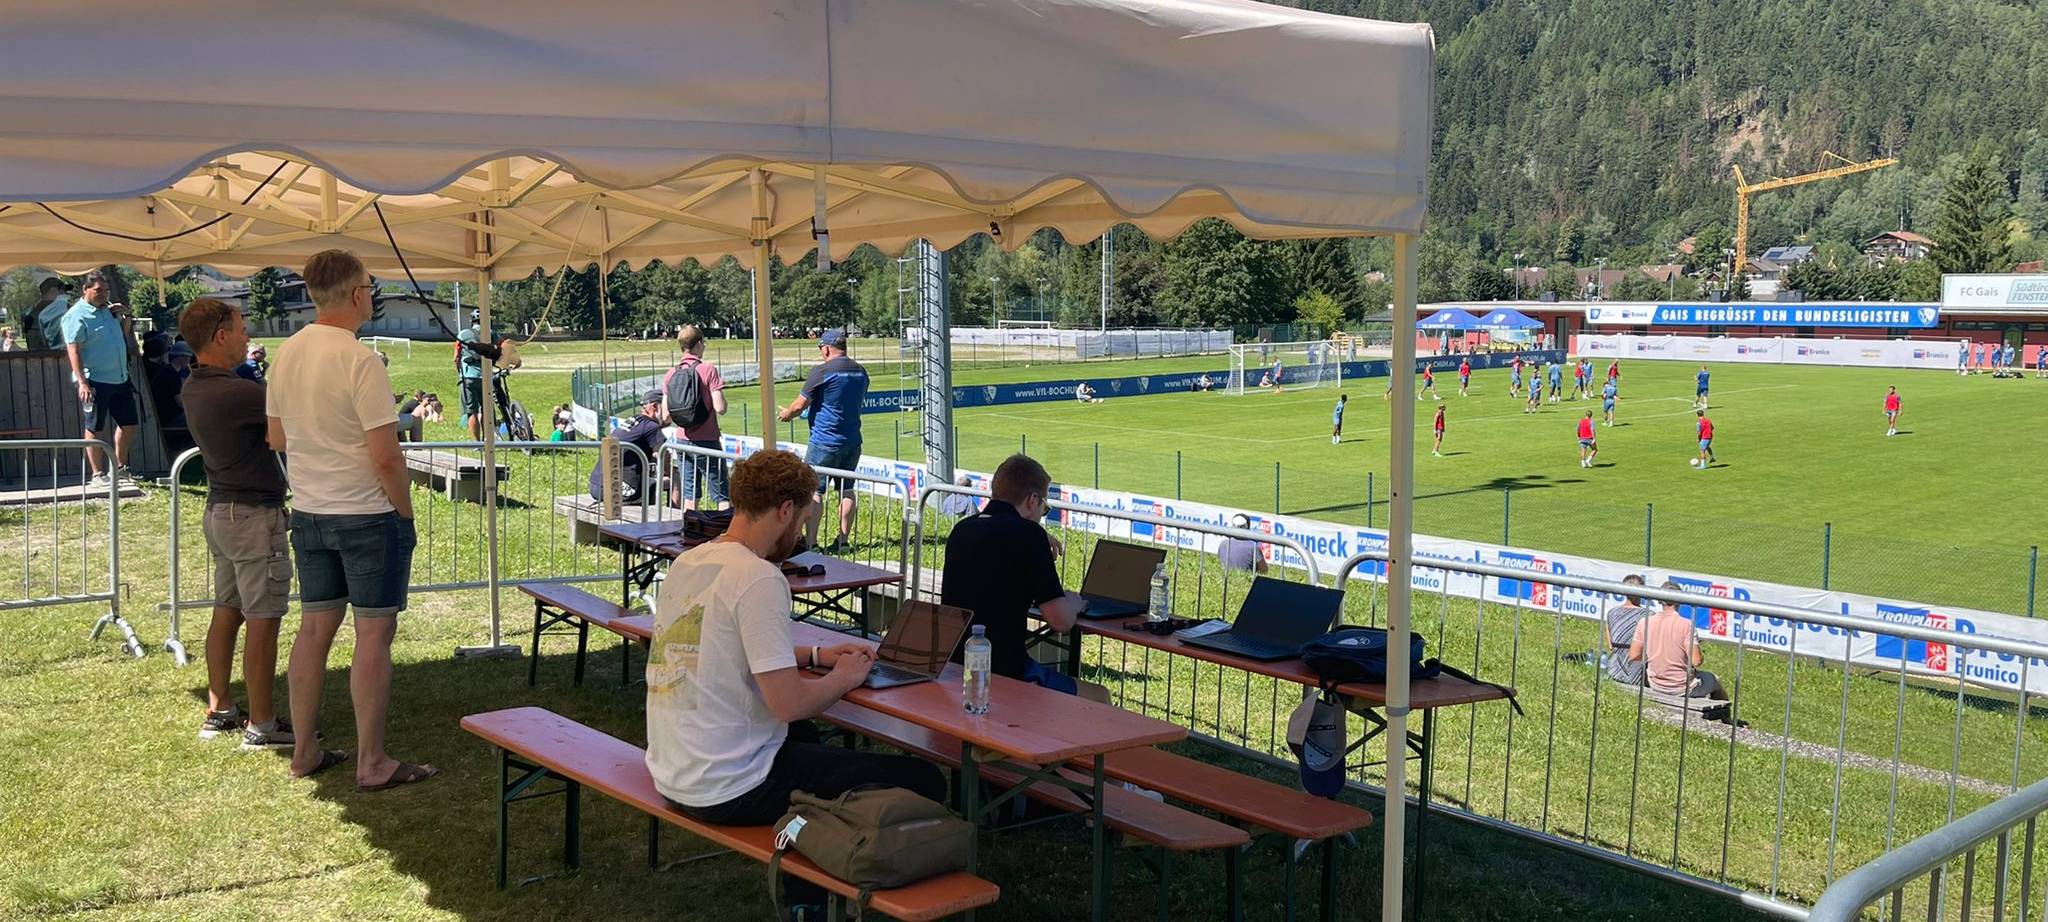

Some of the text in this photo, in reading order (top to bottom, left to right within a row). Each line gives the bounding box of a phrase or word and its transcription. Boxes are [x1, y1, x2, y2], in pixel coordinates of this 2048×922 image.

[1960, 287, 1999, 297] FC Gais
[1661, 307, 1910, 323] GAIS BEGRÜSST DEN BUNDESLIGISTEN
[1071, 516, 1097, 530] Brunco
[1274, 521, 1349, 559] Buneck
[1356, 536, 1389, 549] KRONPL
[1498, 556, 1548, 573] KRONPLATZ
[1412, 574, 1440, 589] unico
[1679, 583, 1728, 598] ONPLATZ
[1876, 610, 1947, 630] KRONPLATZ
